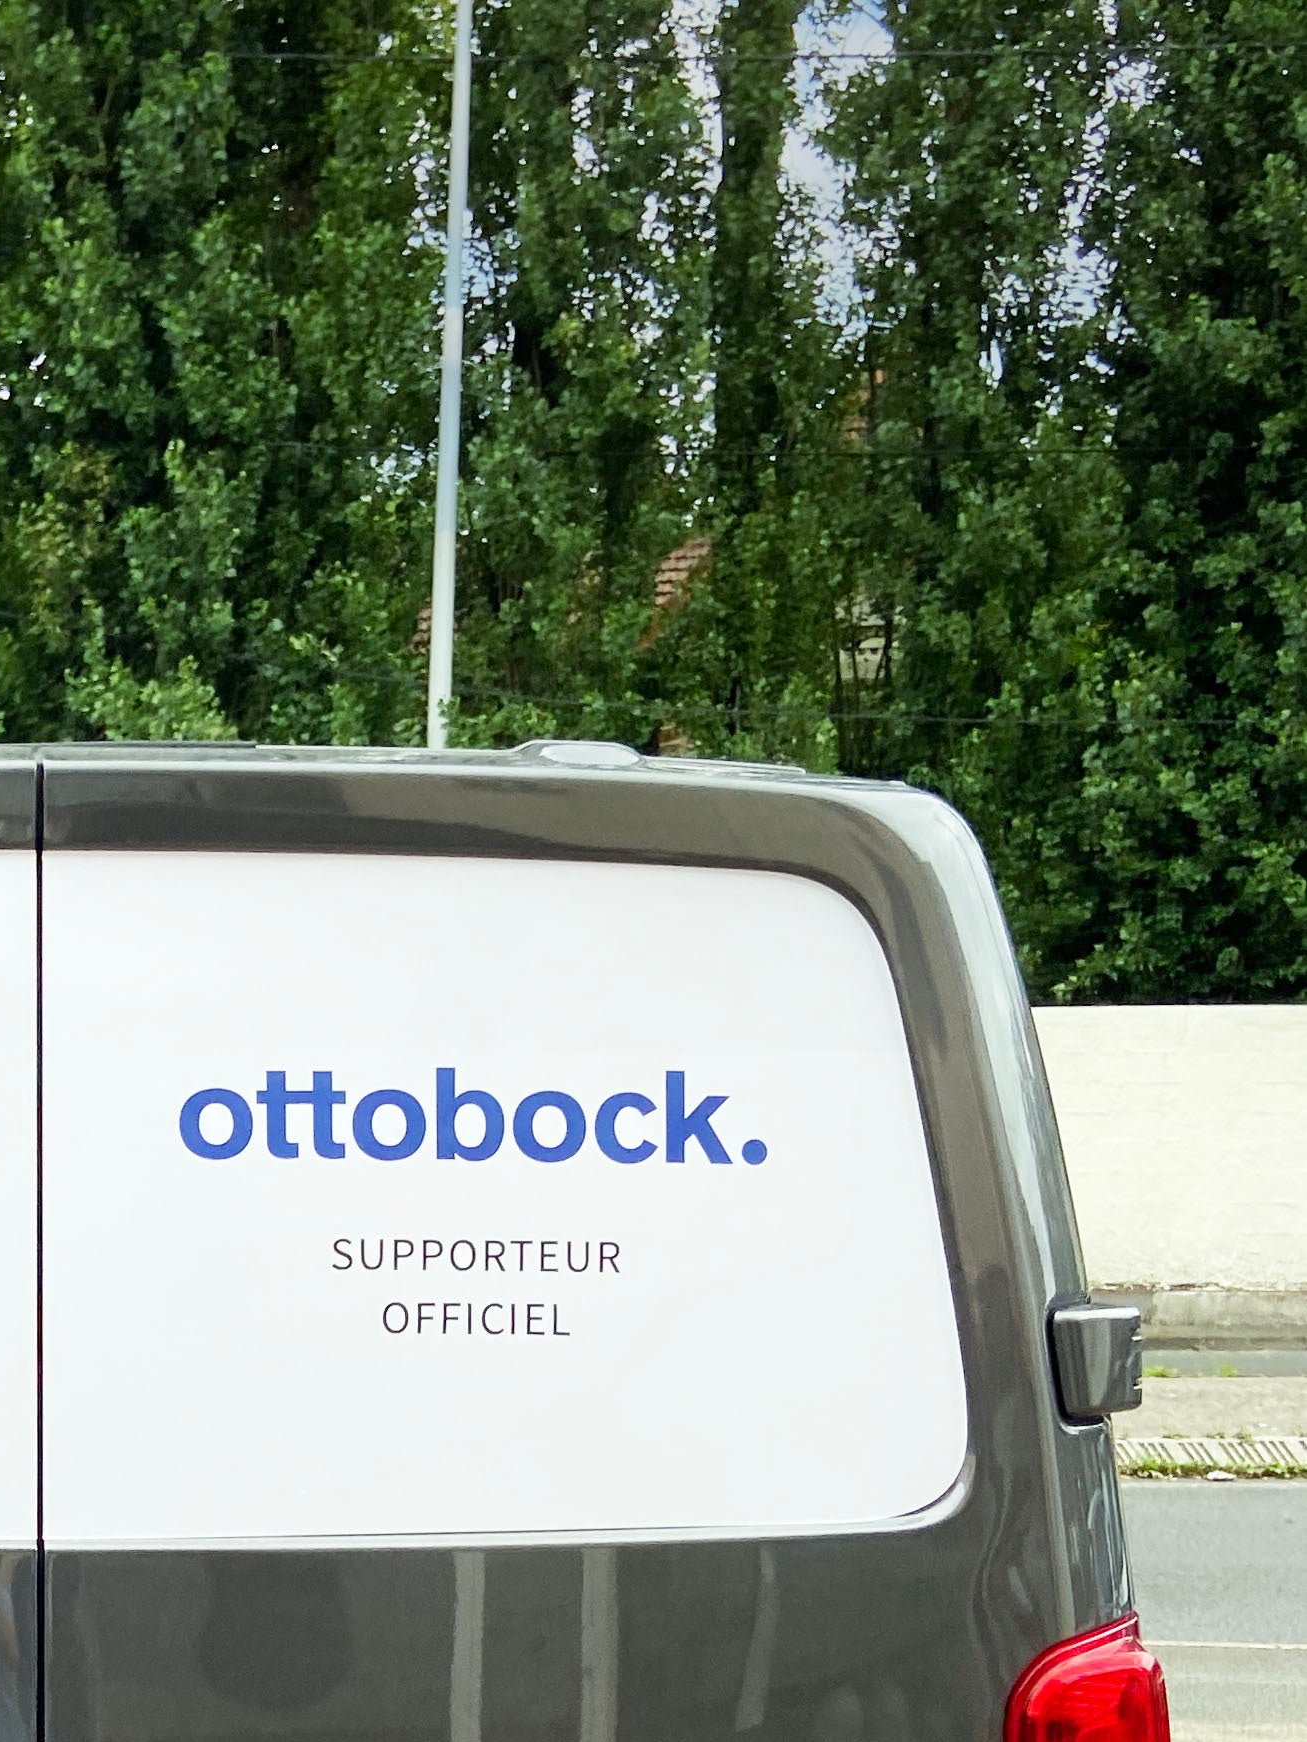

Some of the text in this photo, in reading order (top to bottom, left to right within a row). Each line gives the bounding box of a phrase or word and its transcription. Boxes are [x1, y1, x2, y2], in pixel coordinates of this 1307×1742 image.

[178, 1067, 768, 1166] ottobock.
[331, 1238, 622, 1275] SUPPORTEUR
[381, 1301, 572, 1337] OFFICIEL
